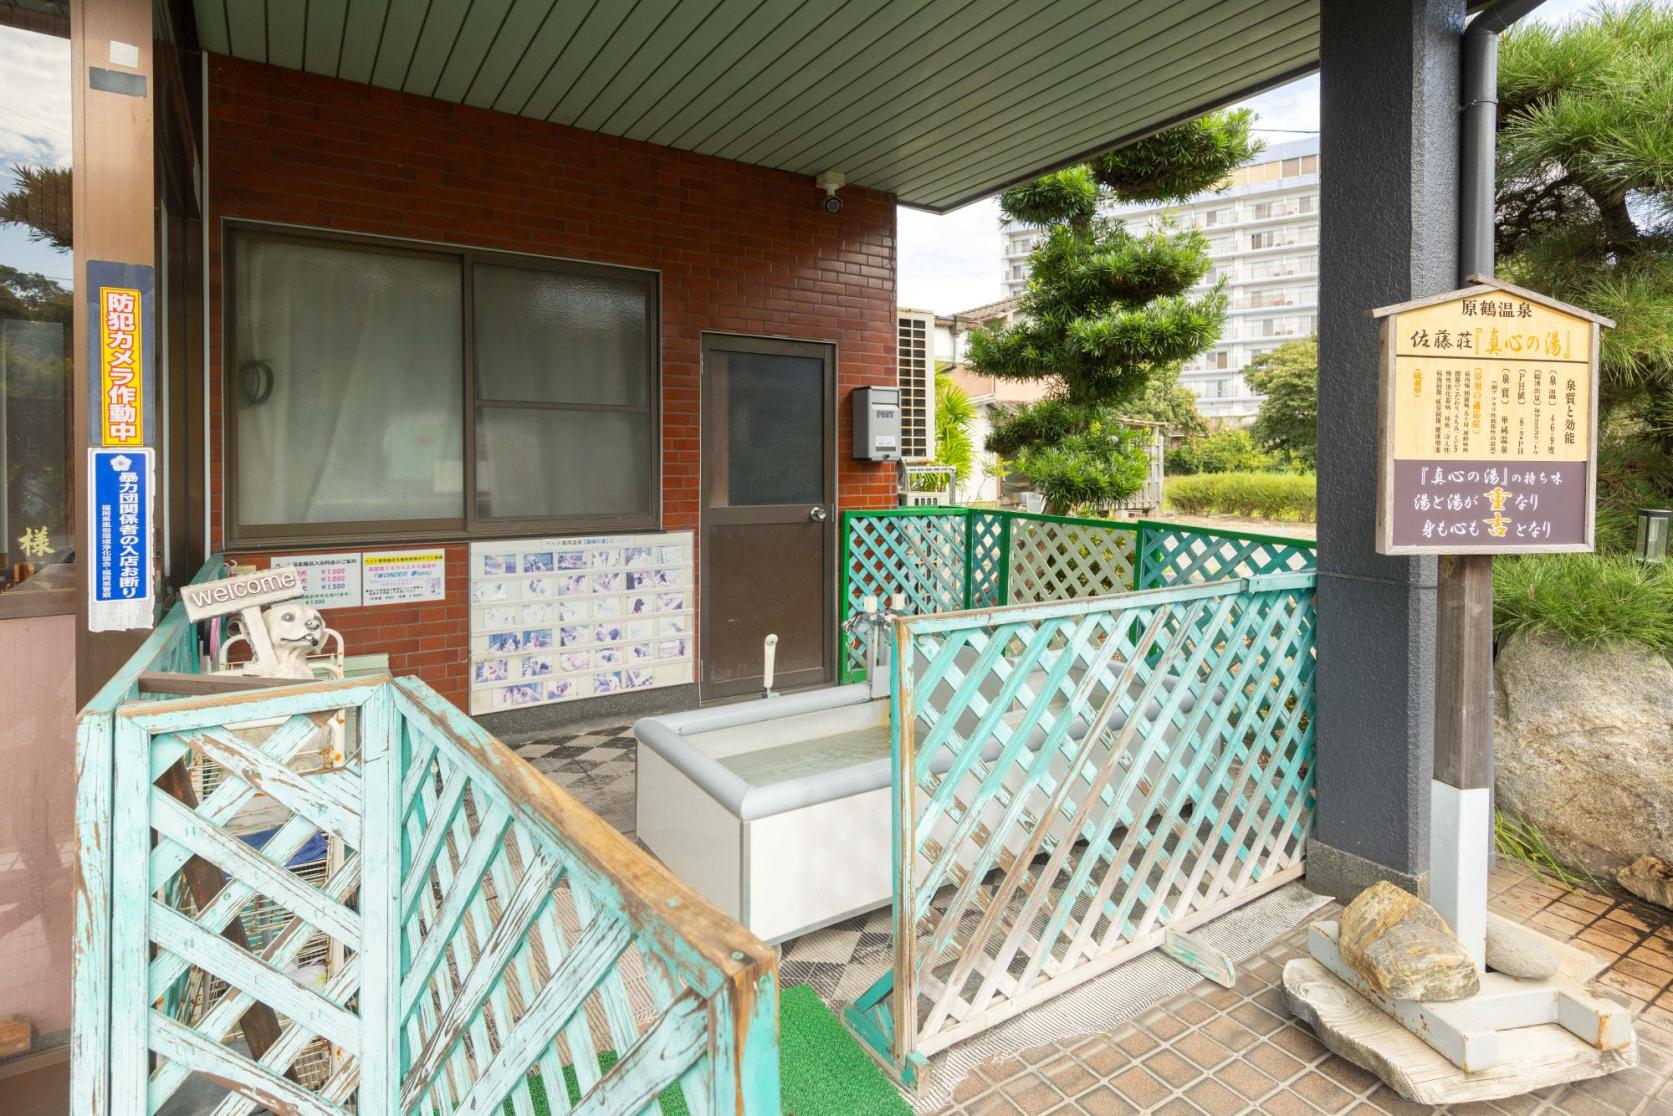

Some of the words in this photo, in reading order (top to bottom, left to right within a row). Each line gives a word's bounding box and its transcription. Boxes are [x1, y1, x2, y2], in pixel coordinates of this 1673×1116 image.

[1461, 299, 1533, 318] 原鶴温泉
[107, 292, 136, 442] 防犯カメラ作動中
[1564, 378, 1576, 445] 泉質と効能
[1421, 466, 1564, 486] 『真心の湯』の持ち味
[1413, 486, 1539, 512] 湯と湯が重なり
[18, 525, 56, 557] 様
[118, 472, 139, 598] 暴力団関係者の入店お断り
[191, 571, 296, 607] welcome
